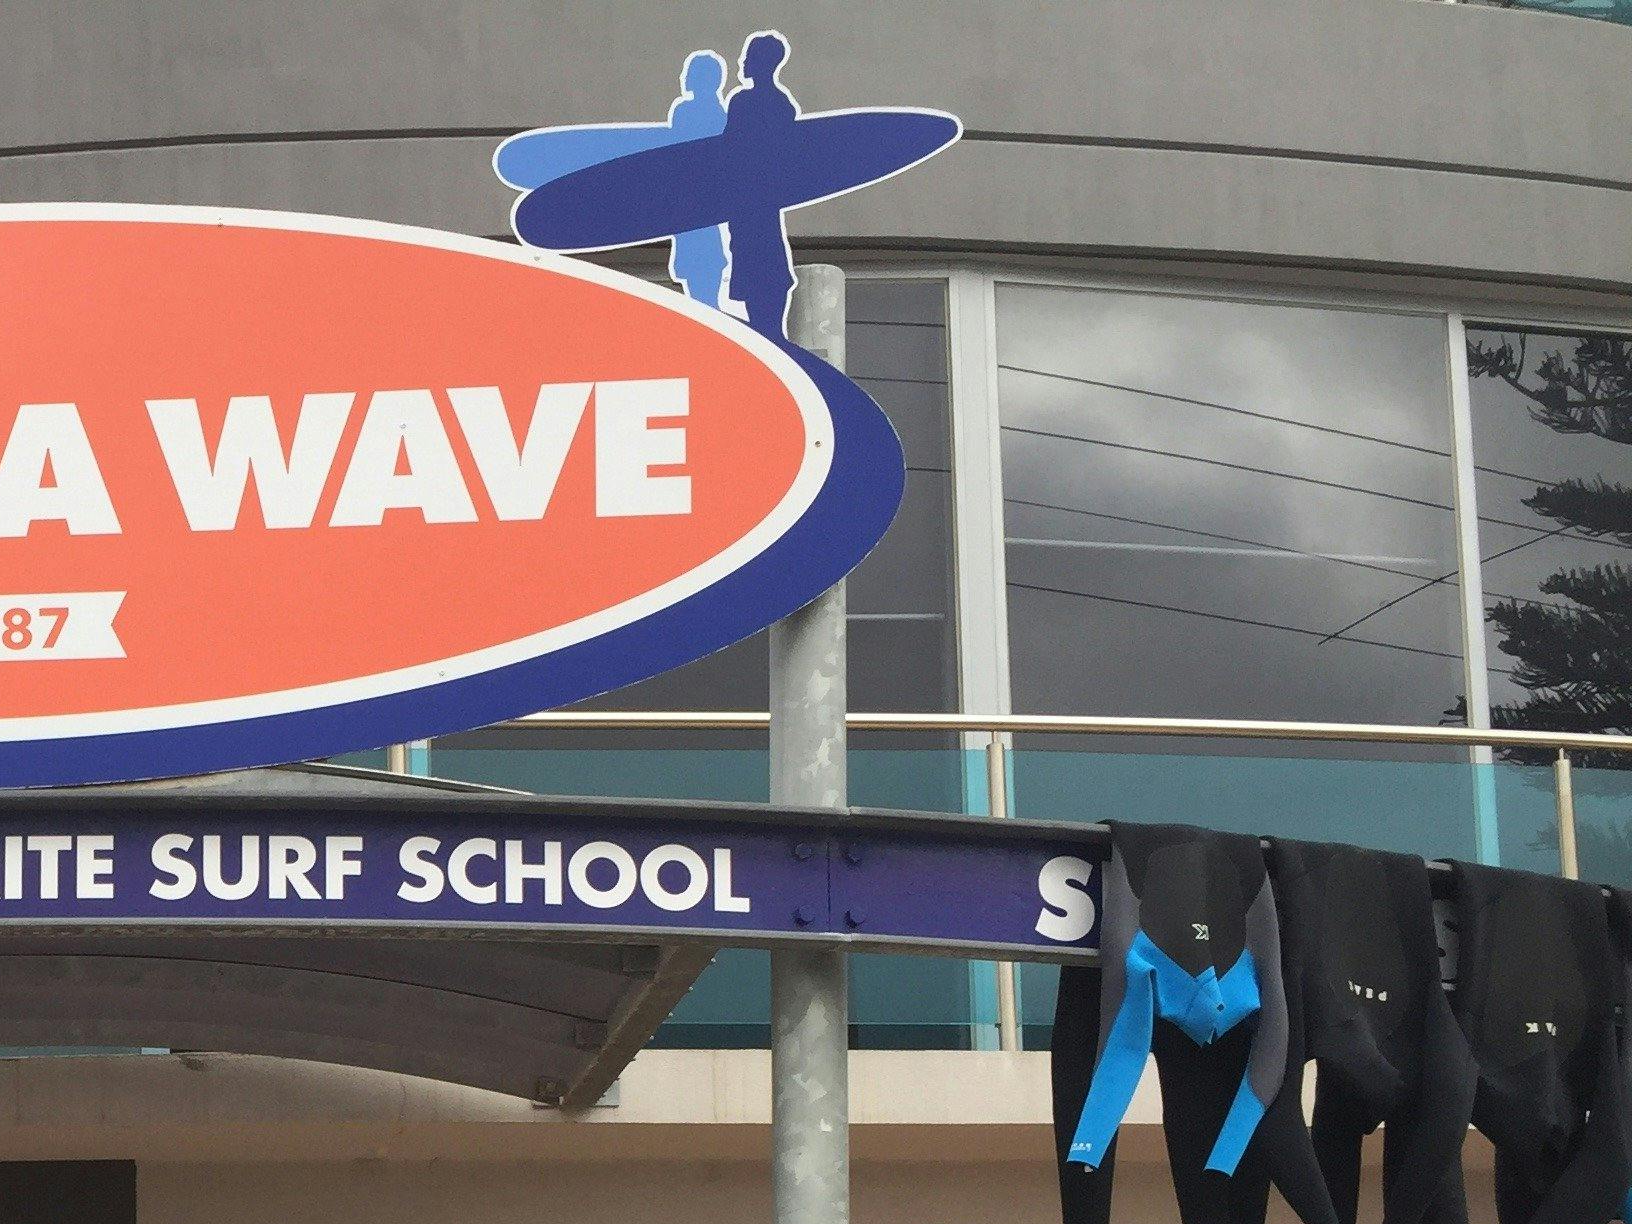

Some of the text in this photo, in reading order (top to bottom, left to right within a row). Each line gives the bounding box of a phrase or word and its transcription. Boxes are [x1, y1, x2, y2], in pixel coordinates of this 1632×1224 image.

[145, 378, 691, 531] WAVE
[148, 832, 364, 902] SURF
[397, 837, 751, 914] SCHOOL
